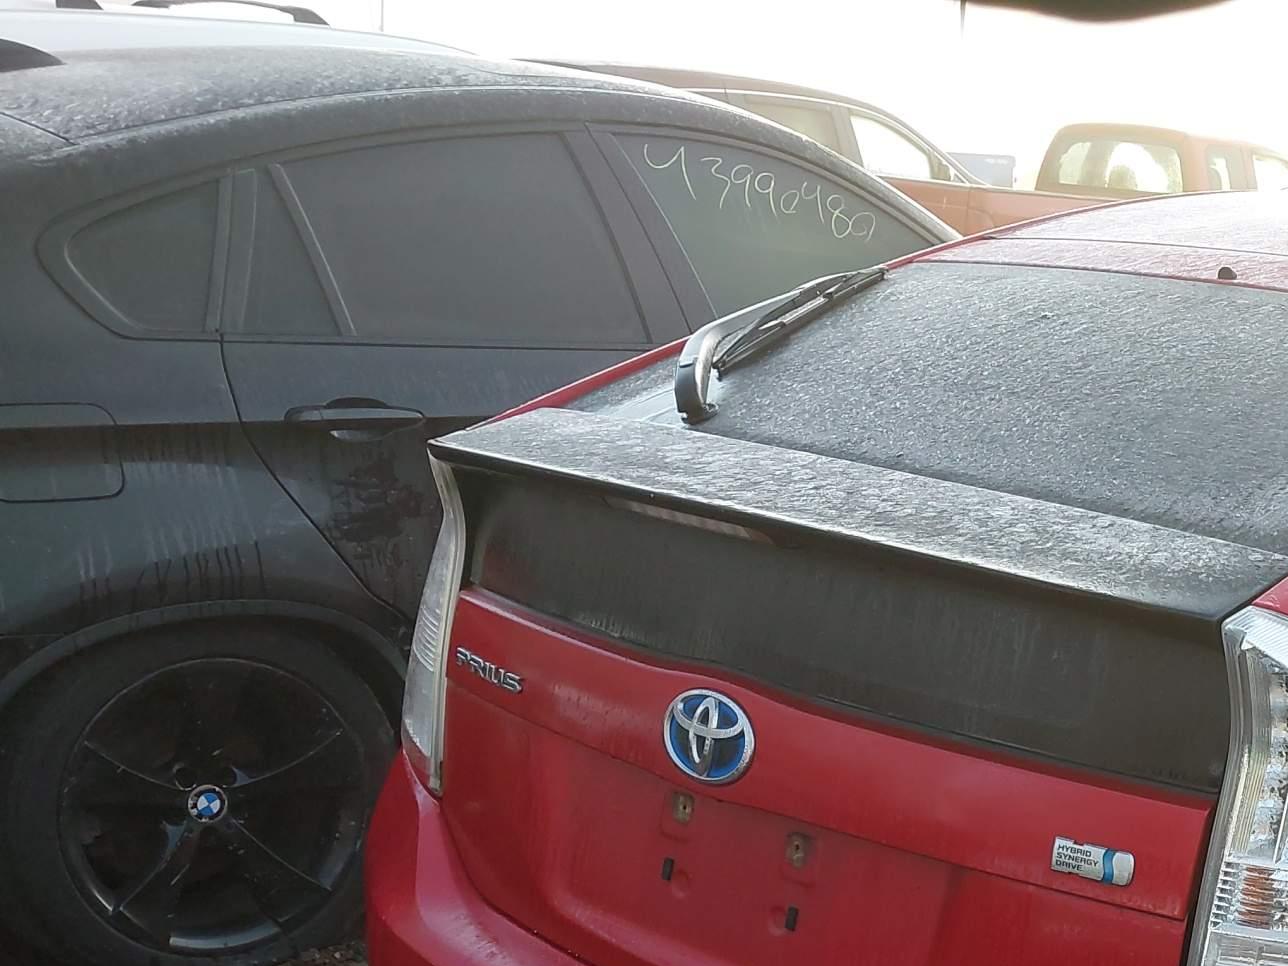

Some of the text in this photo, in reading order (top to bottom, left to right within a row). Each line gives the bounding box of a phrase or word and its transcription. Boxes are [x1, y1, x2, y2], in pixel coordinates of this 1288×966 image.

[456, 647, 523, 693] PRIUS
[1057, 843, 1092, 857] HYBRID
[1055, 859, 1083, 871] DRIVE
[1056, 851, 1099, 867] SYNERGY
